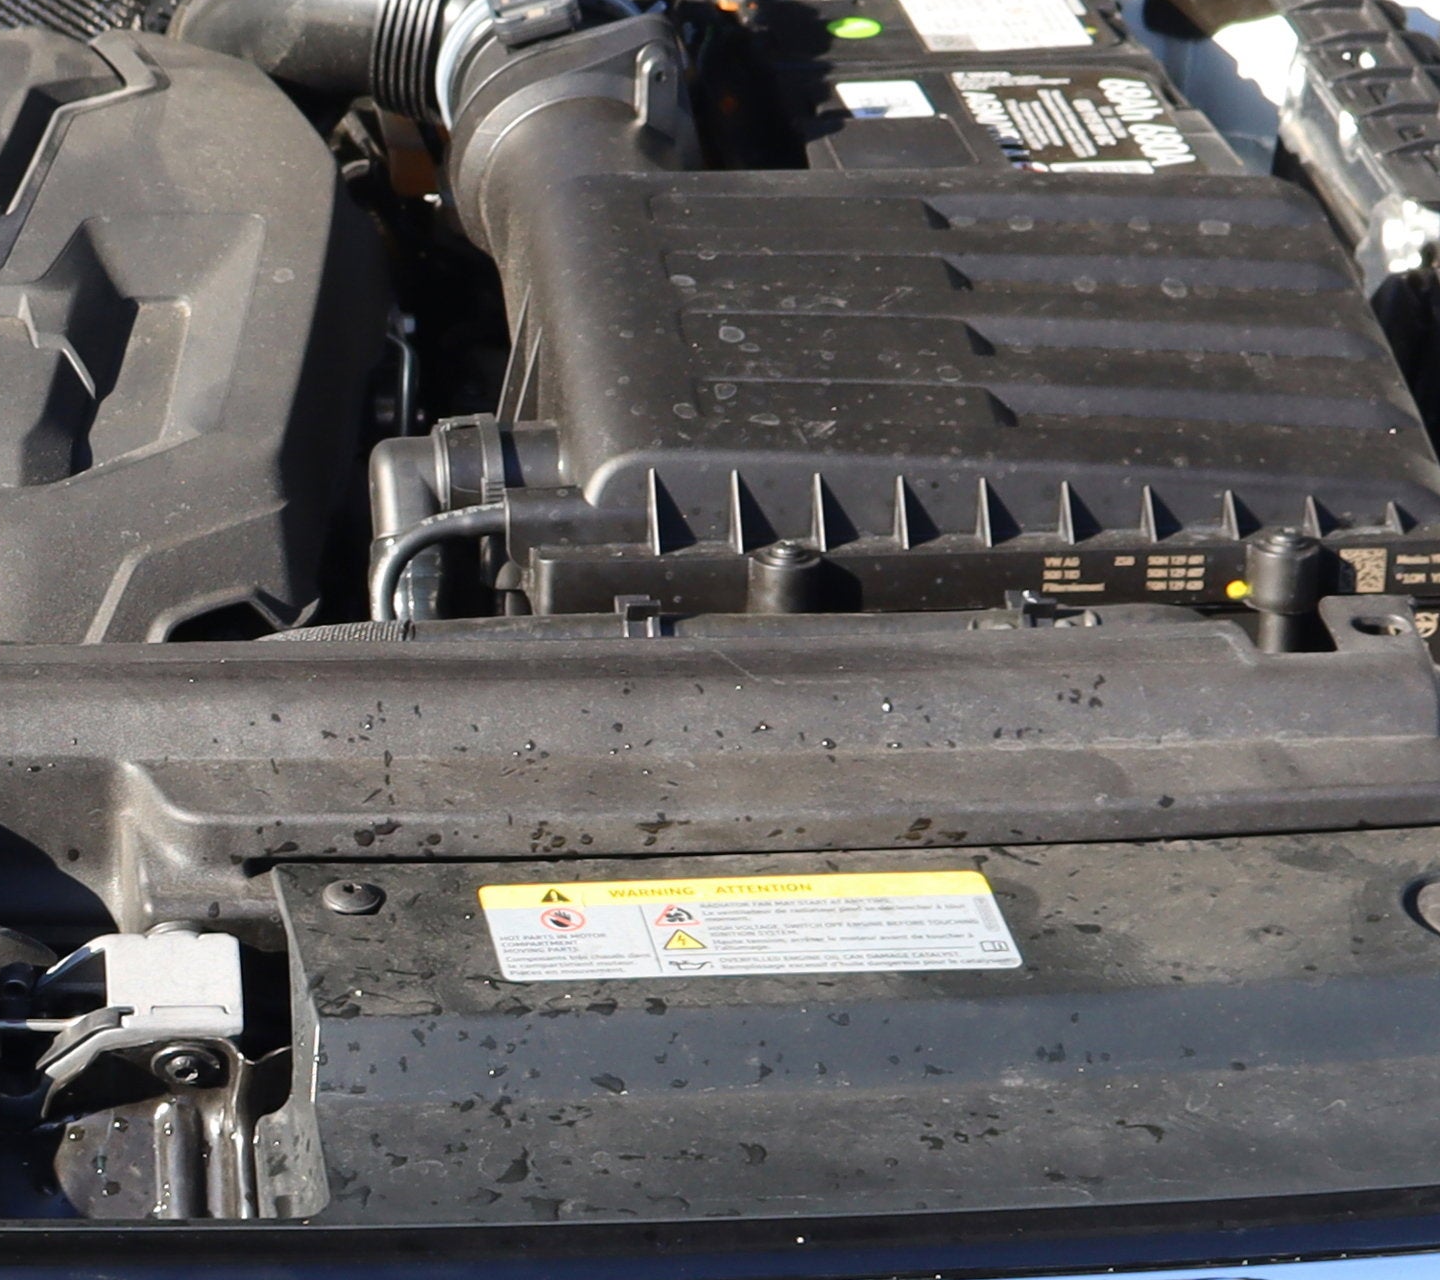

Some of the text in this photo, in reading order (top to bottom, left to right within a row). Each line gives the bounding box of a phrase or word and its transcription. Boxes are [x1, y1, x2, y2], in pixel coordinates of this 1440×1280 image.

[1098, 78, 1163, 121] 68Ah
[1128, 123, 1196, 167] 680A
[608, 883, 813, 898] WARNING ATTENTION
